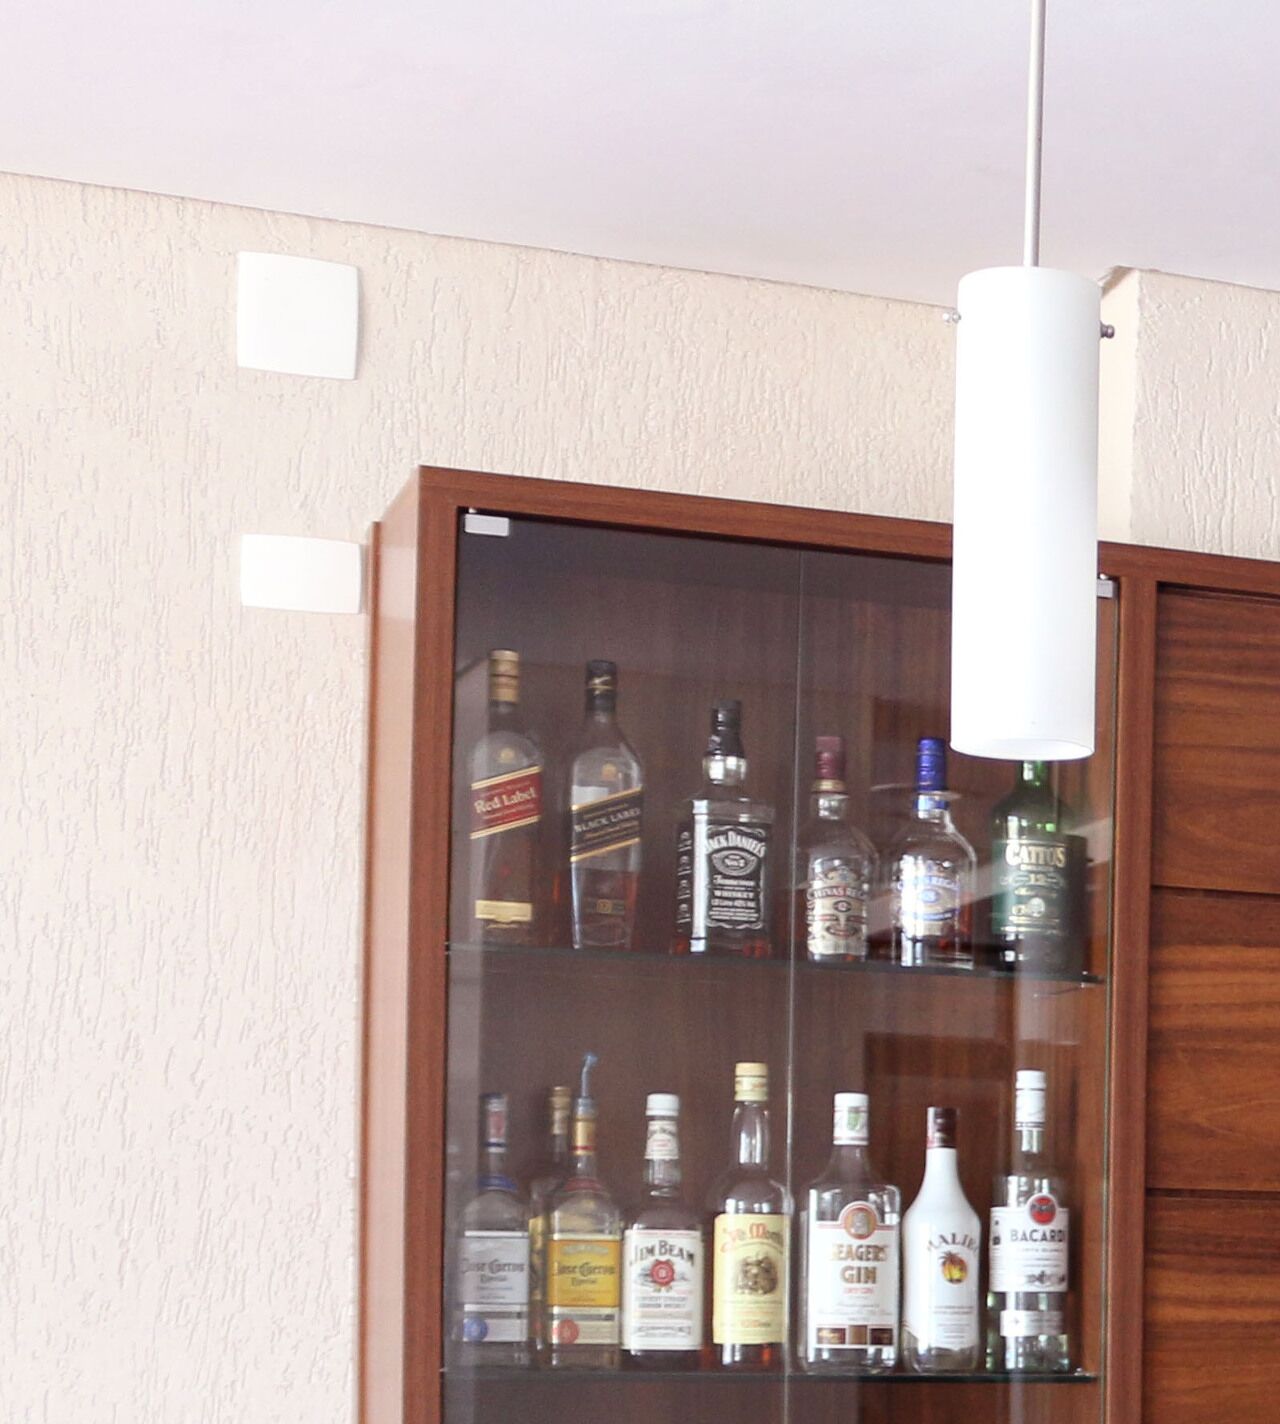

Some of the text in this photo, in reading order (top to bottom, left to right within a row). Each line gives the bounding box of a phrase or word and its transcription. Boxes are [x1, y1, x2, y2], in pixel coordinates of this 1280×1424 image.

[473, 786, 537, 814] Red Label
[574, 817, 609, 833] BLACK
[611, 807, 641, 822] LABEL
[728, 831, 767, 858] DANIEL'S
[630, 1240, 694, 1266] JIM BEAM
[840, 1265, 877, 1284] GIN
